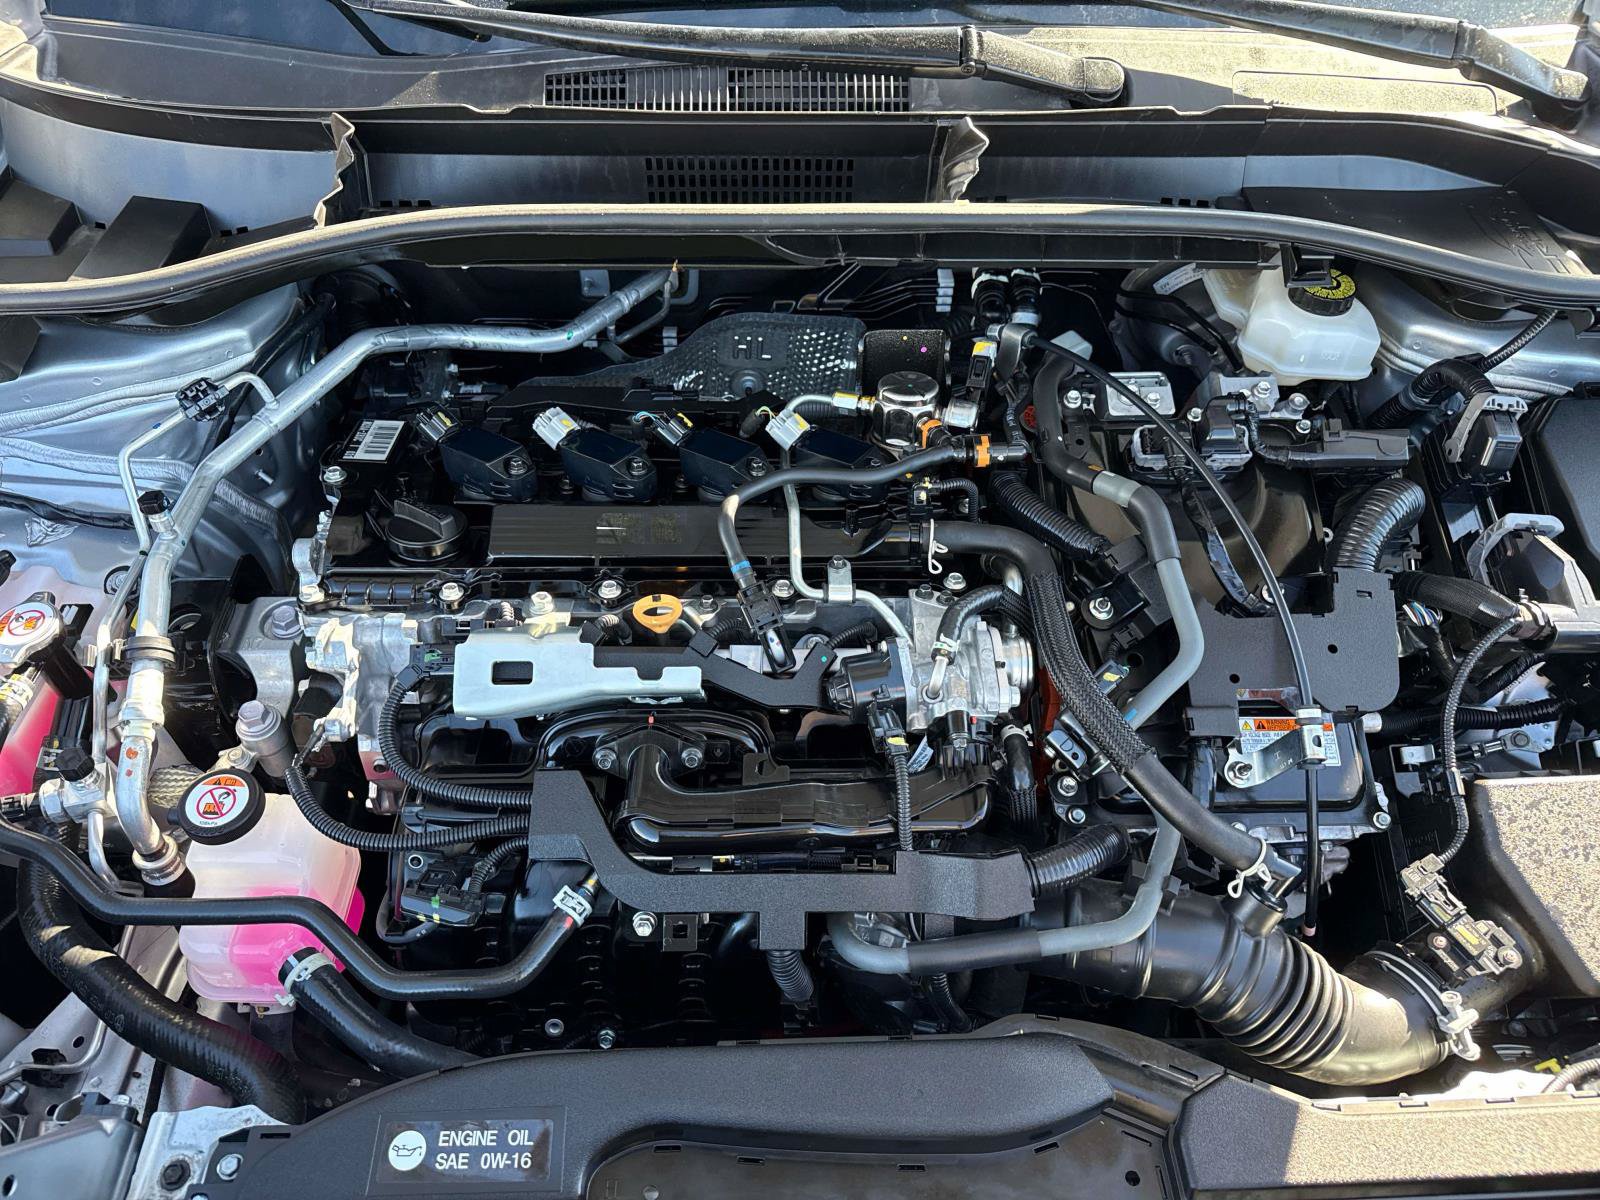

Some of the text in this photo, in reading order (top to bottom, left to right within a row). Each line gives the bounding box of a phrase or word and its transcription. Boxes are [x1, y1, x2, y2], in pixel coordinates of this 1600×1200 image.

[438, 1129, 534, 1146] ENGINE OIL
[435, 1152, 532, 1170] SAE 0W-16
